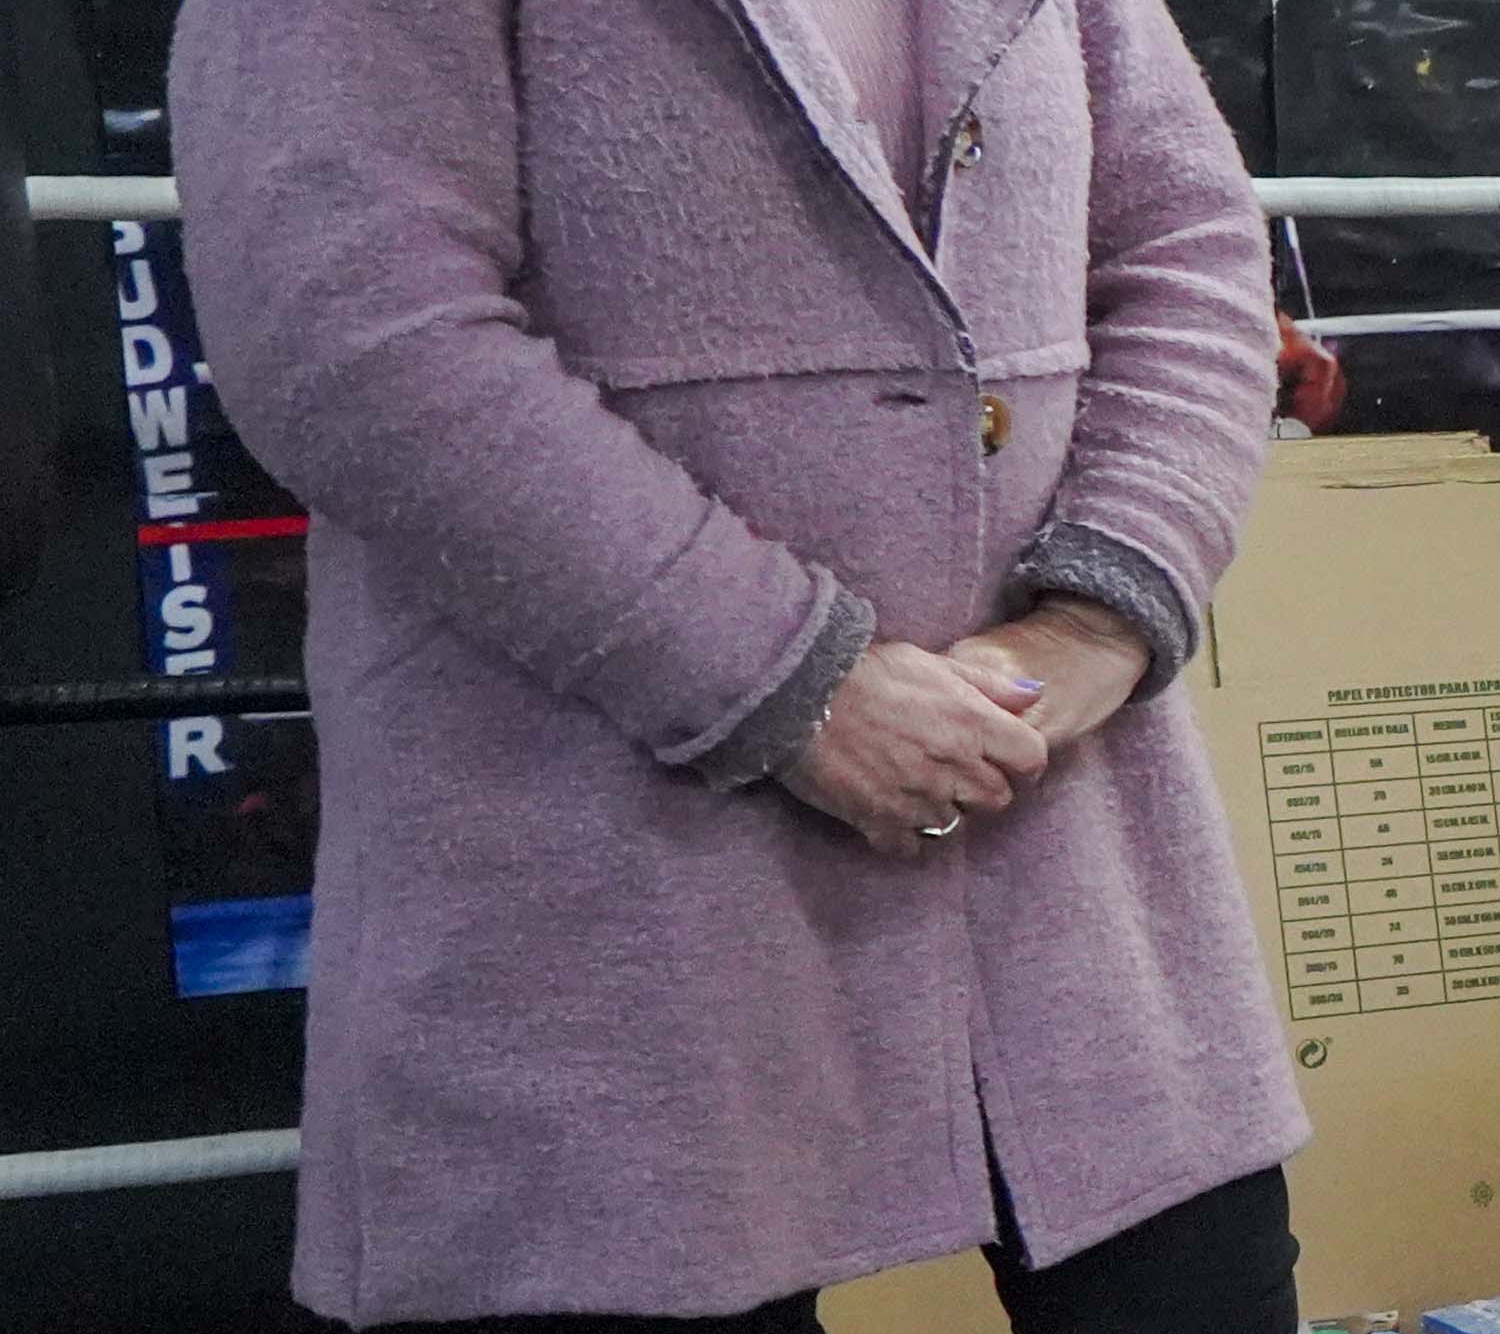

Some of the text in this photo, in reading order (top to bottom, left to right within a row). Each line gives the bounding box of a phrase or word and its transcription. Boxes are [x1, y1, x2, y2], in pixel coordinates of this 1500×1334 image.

[1327, 687, 1362, 704] PAPEL
[1365, 683, 1436, 702] PROTECTOR
[1438, 681, 1470, 696] PARA
